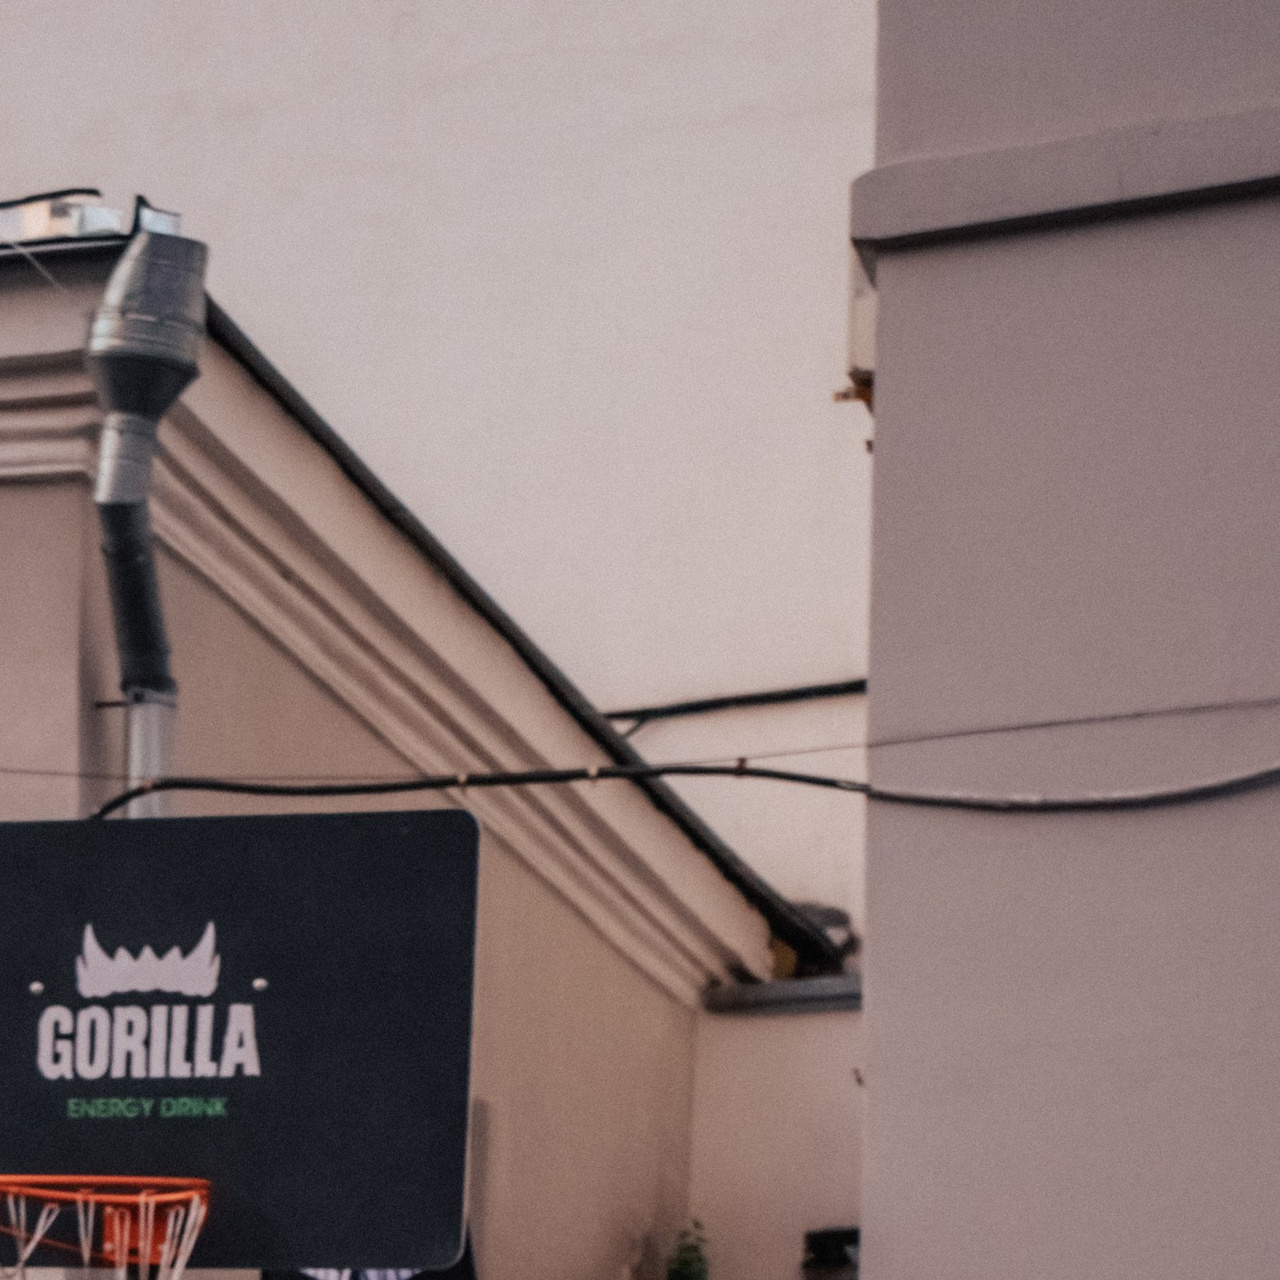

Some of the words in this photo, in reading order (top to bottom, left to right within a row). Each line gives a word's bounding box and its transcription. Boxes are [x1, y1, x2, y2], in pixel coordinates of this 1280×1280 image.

[37, 1003, 262, 1081] GORILLA
[66, 1097, 155, 1119] ENERGY
[159, 1097, 228, 1119] DRINK
